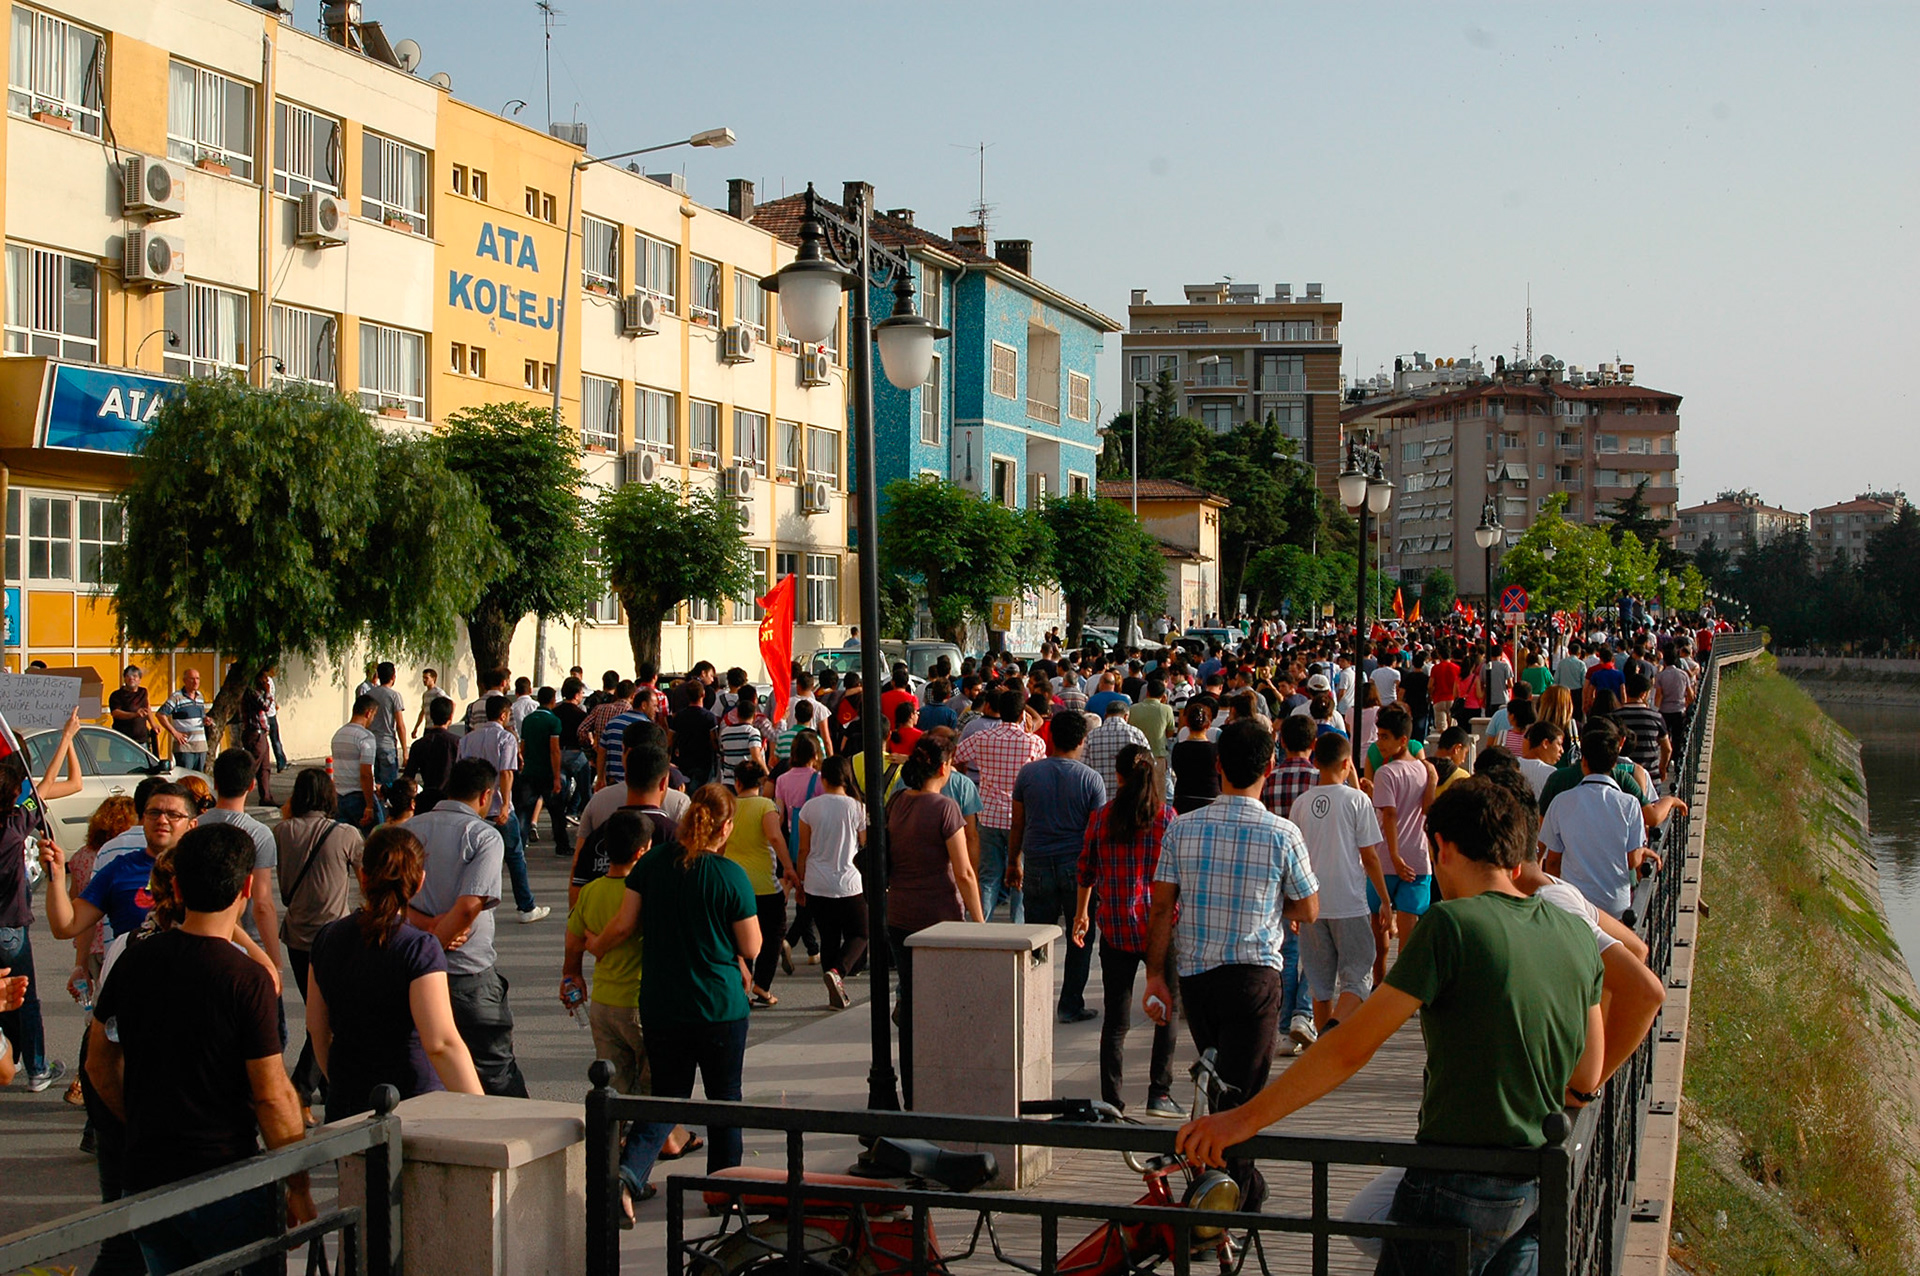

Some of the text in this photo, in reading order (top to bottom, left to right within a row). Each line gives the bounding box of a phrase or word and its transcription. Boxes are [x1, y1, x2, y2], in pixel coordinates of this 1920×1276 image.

[476, 222, 539, 273] ATA
[98, 386, 164, 422] ATA
[1315, 799, 1327, 814] 90
